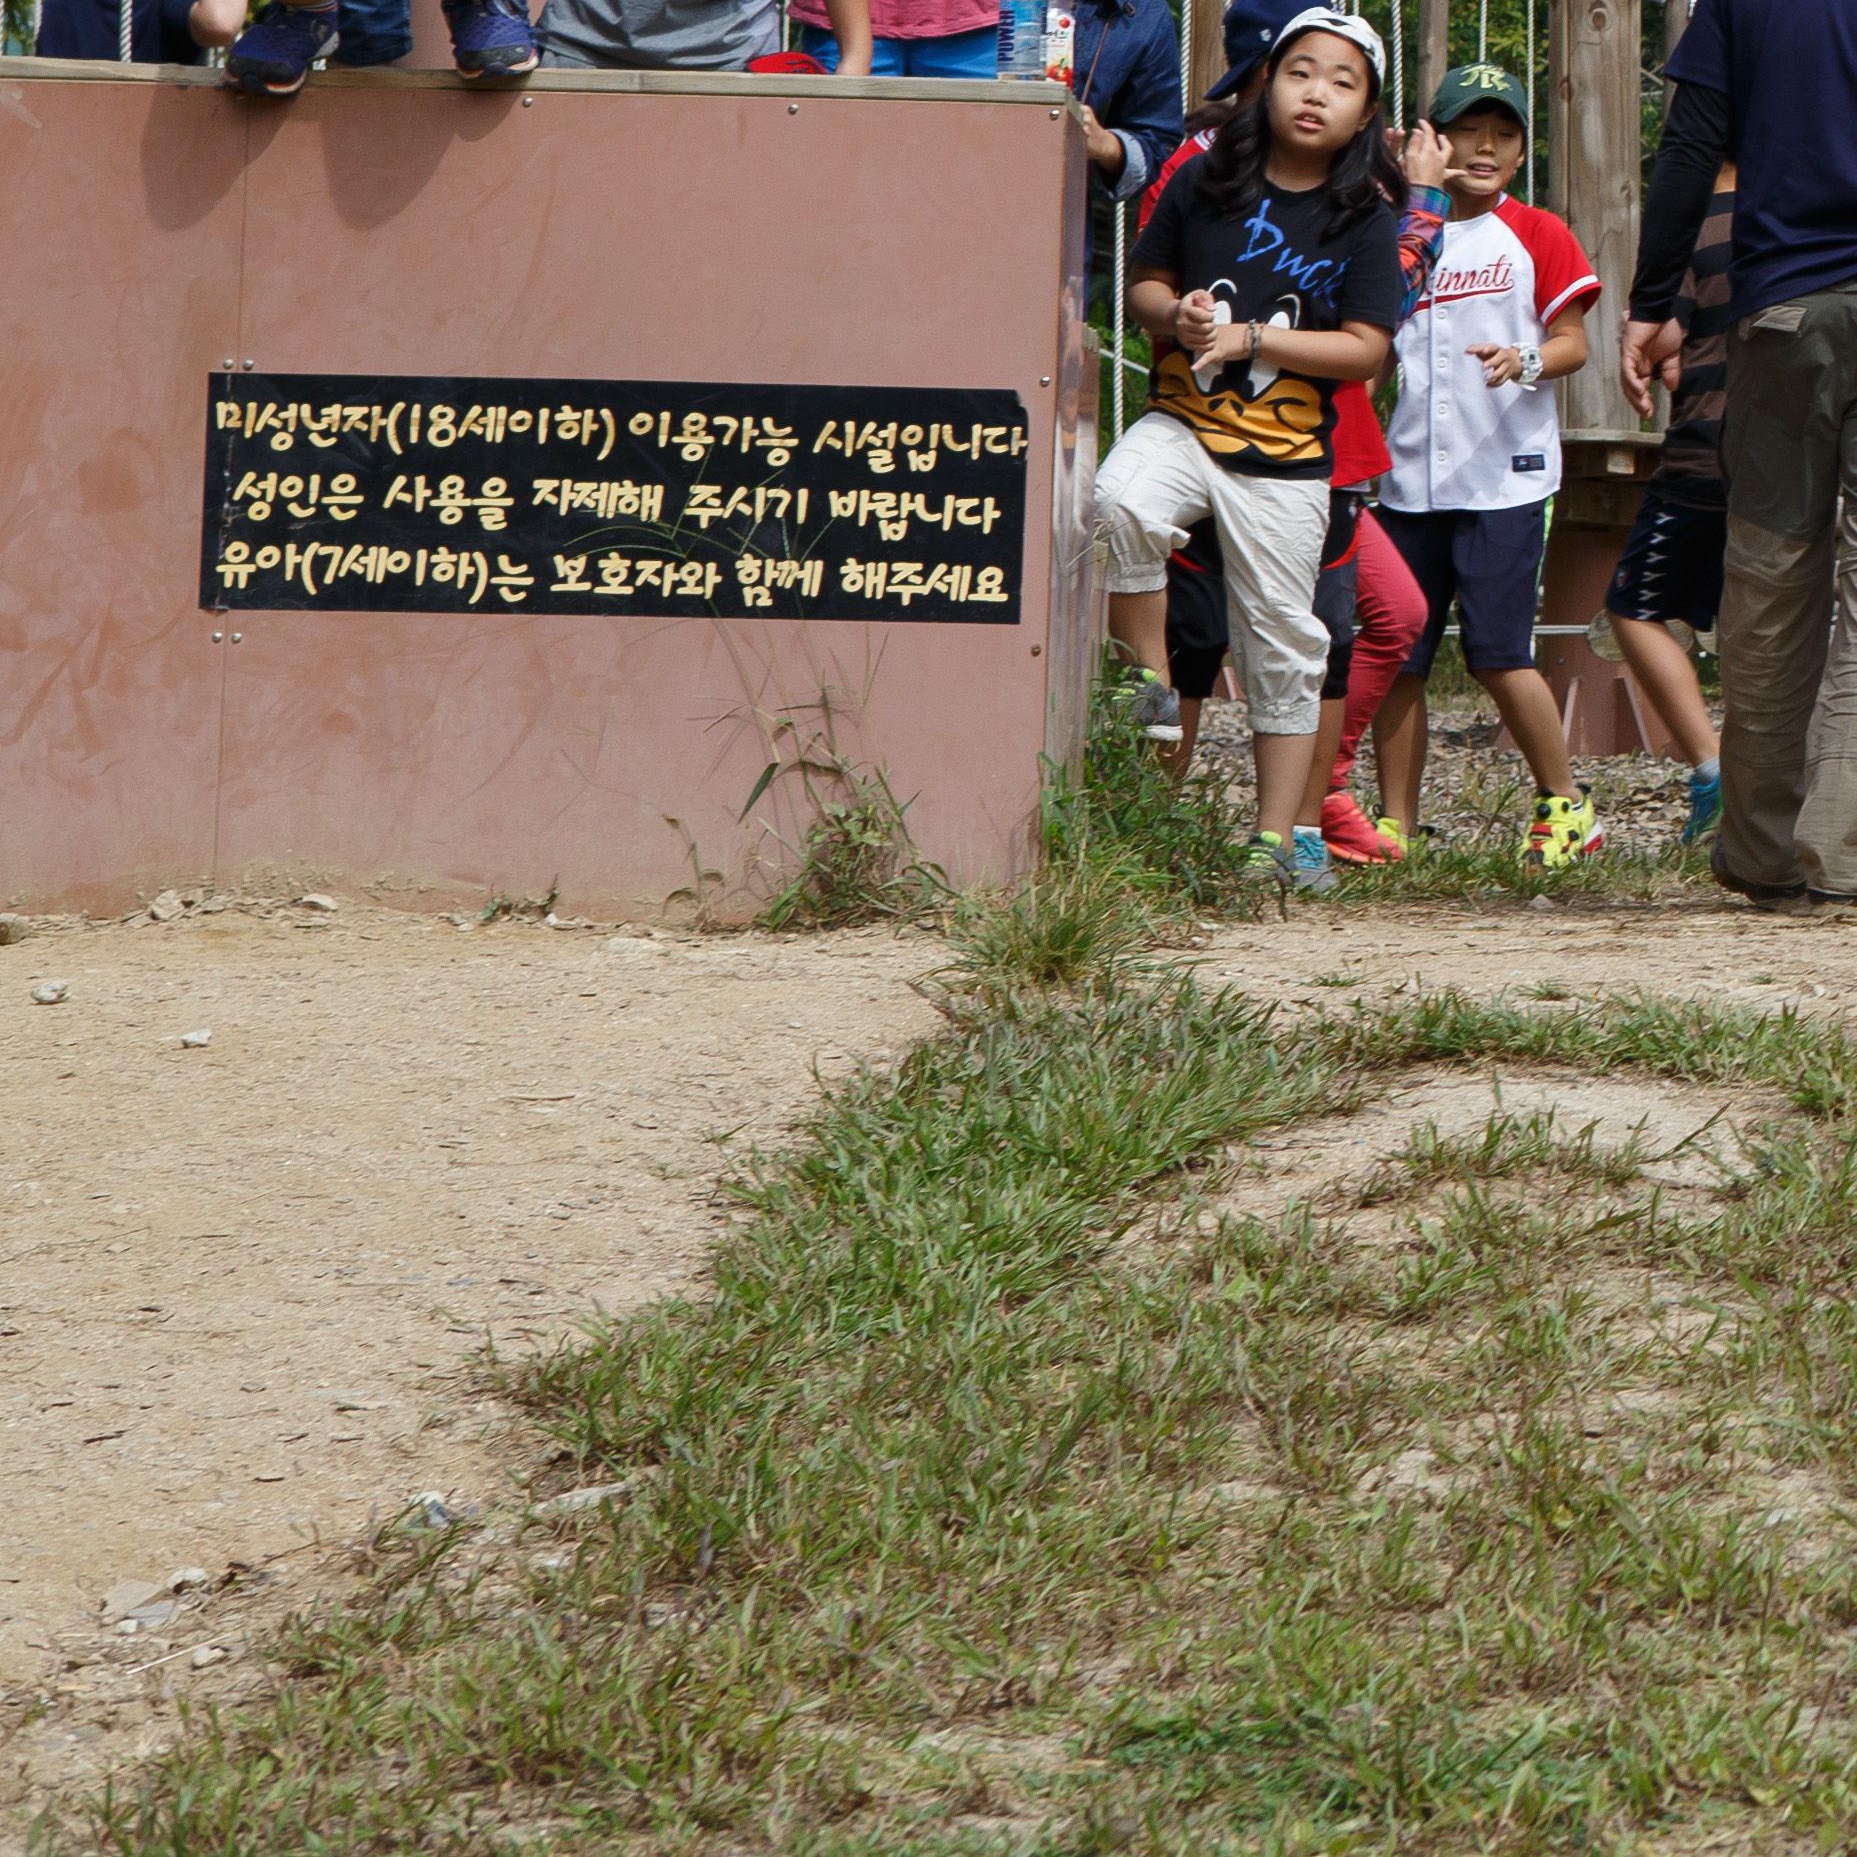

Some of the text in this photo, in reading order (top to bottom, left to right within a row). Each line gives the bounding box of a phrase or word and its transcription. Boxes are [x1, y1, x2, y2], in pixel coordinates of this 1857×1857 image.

[215, 401, 1029, 474] 미성년자(18세이하) 이용가능 시설입니다
[232, 471, 1002, 542] 성인은 사용을 자제해 주시기 바랍니다
[215, 540, 1009, 607] 유아(7세이하)는 보호자와 함께 해주세요
